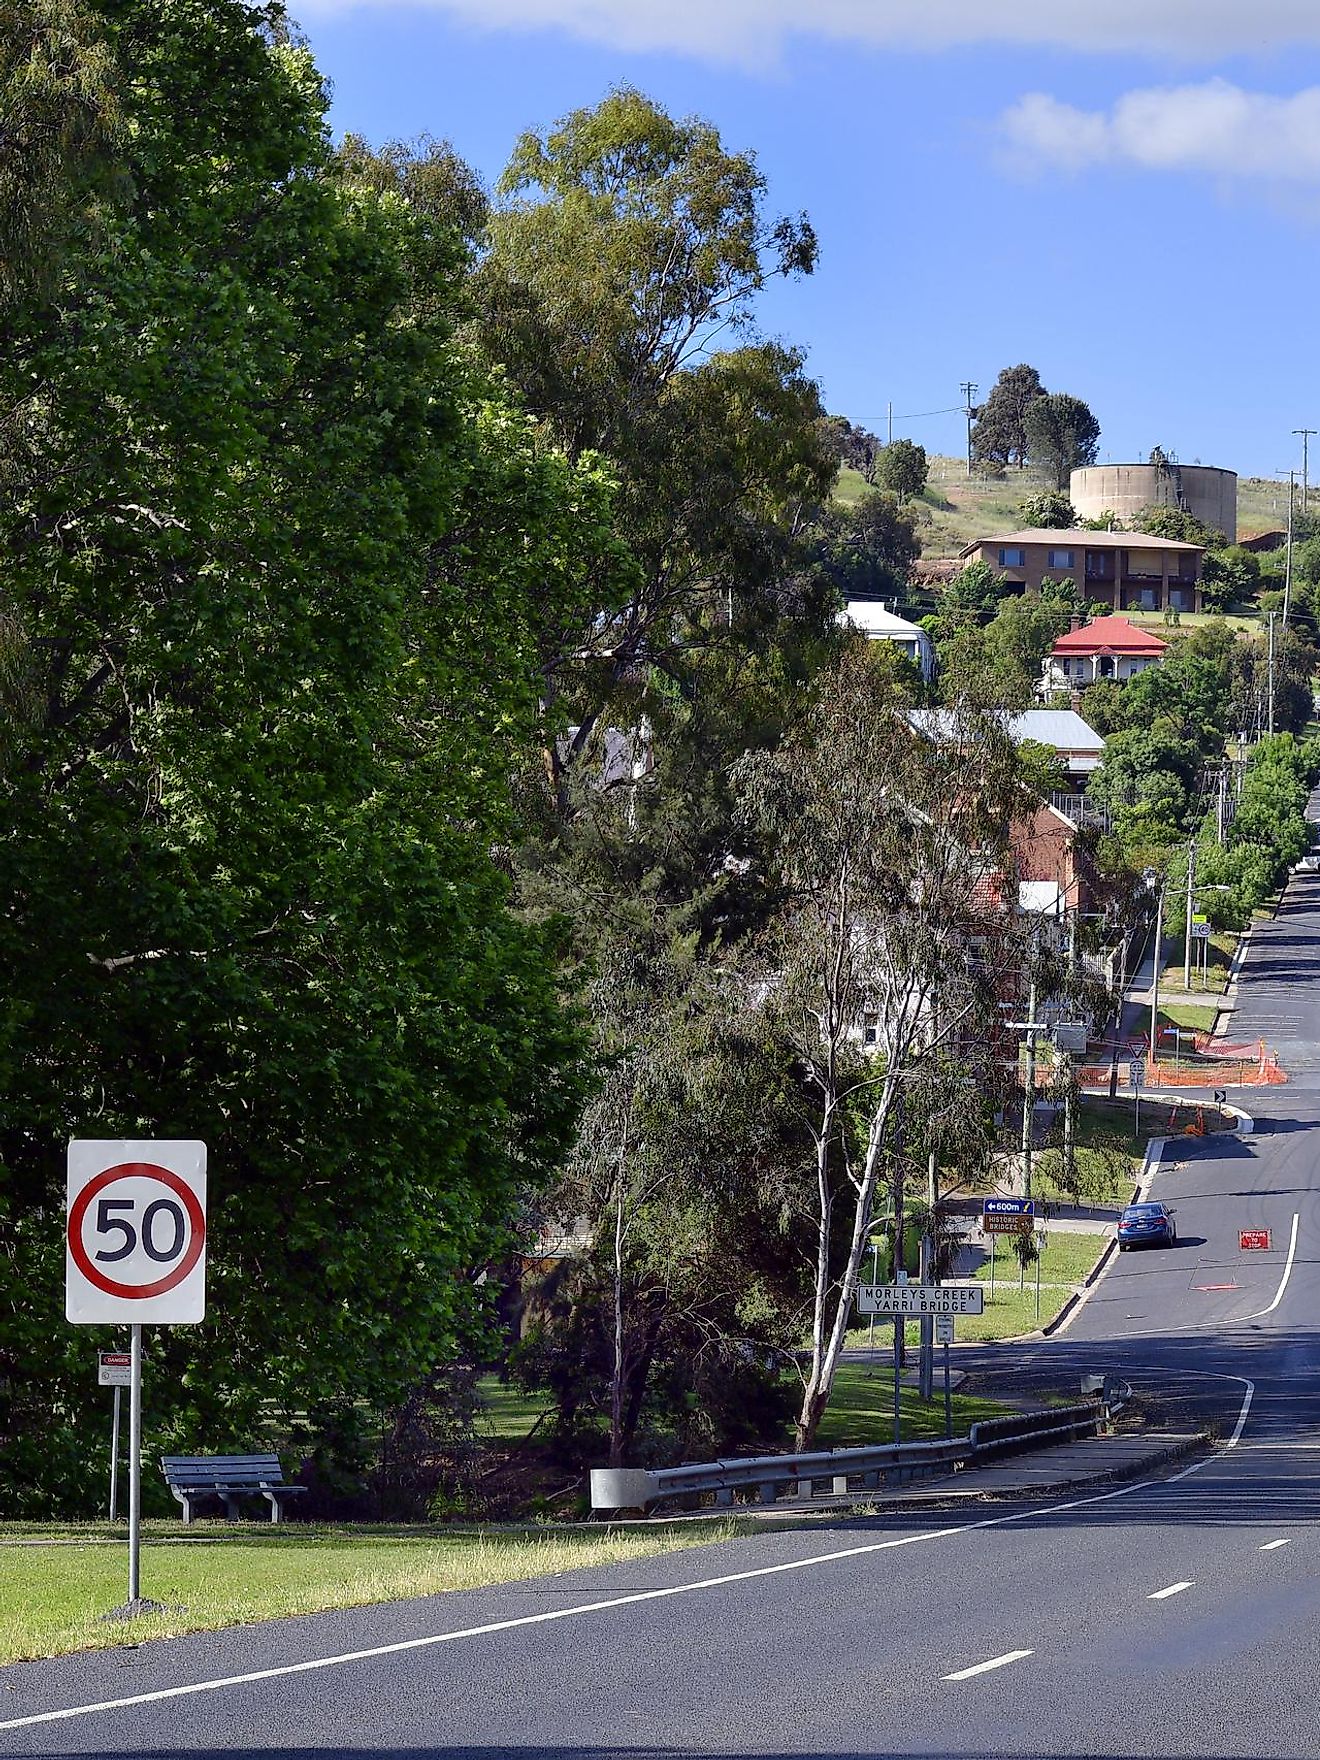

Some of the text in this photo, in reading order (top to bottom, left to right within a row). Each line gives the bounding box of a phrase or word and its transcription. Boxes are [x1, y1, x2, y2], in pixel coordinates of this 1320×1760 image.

[996, 1202, 1020, 1211] 600m
[95, 1199, 185, 1262] 50
[865, 1289, 976, 1300] MORLEYS CREEK
[875, 1300, 967, 1311] YARRI BRIDGE
